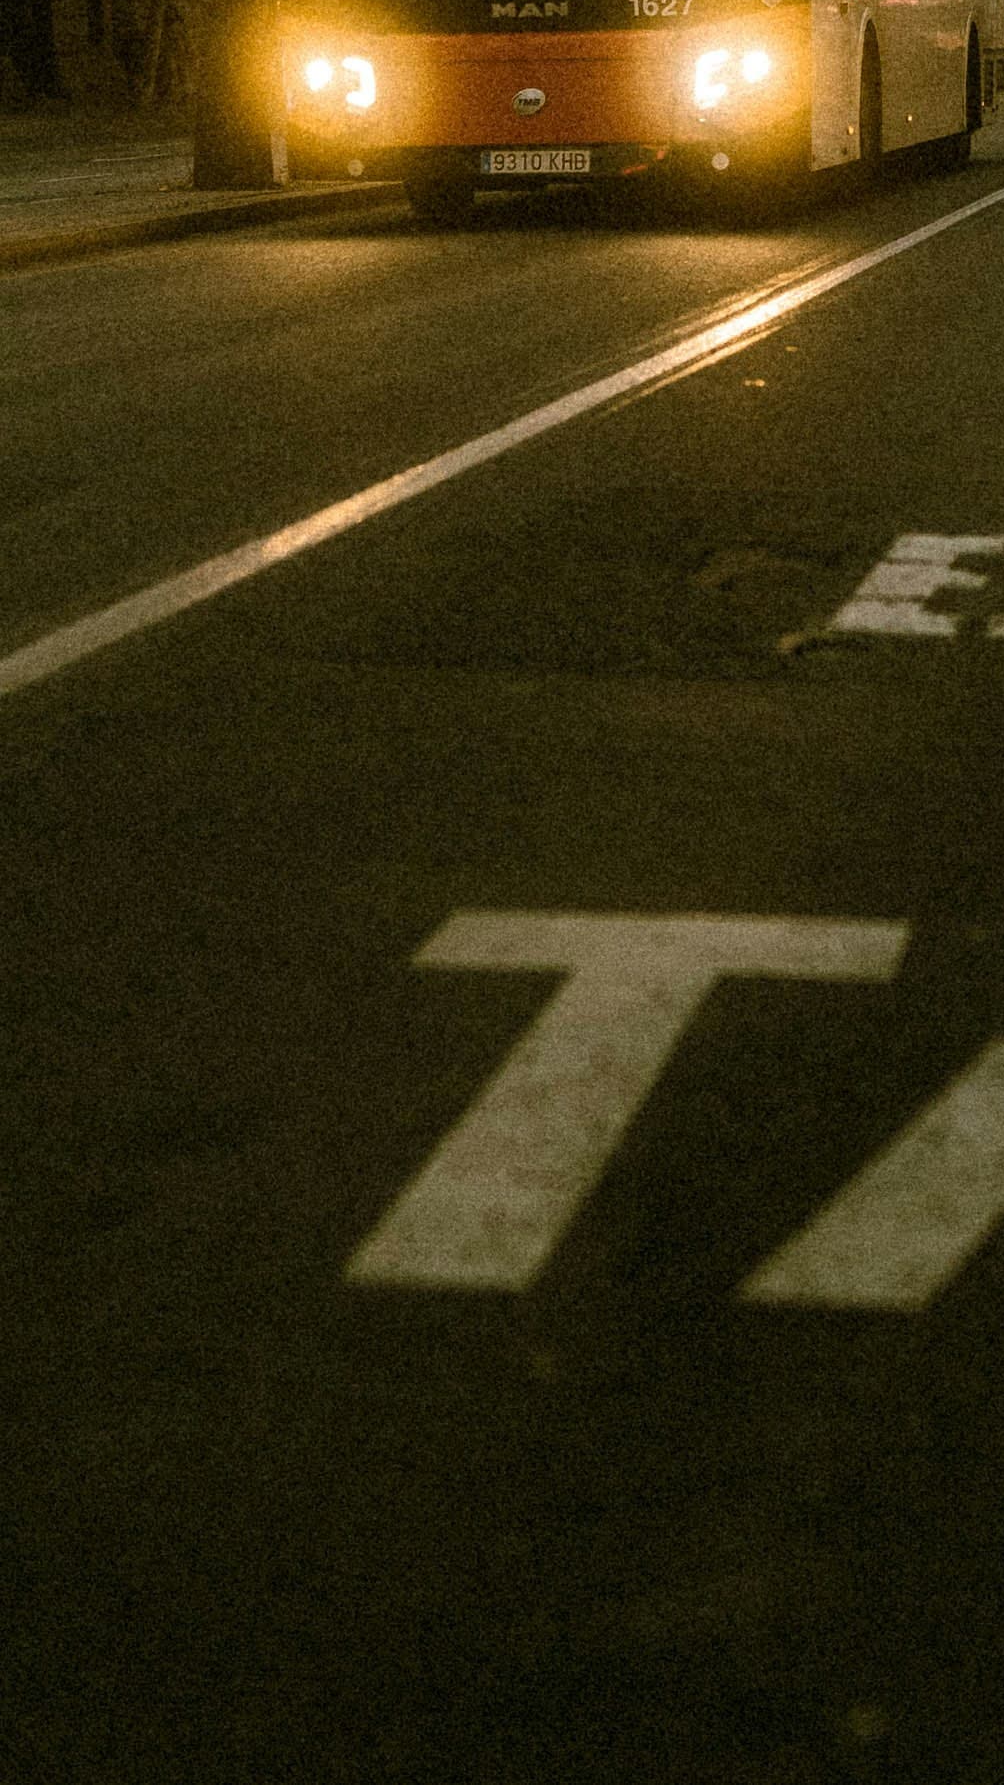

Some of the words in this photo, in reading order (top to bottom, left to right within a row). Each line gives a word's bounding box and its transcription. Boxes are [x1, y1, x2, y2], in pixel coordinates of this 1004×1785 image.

[491, 1, 568, 17] MAN
[494, 153, 542, 171] 9310
[549, 153, 586, 171] KHB
